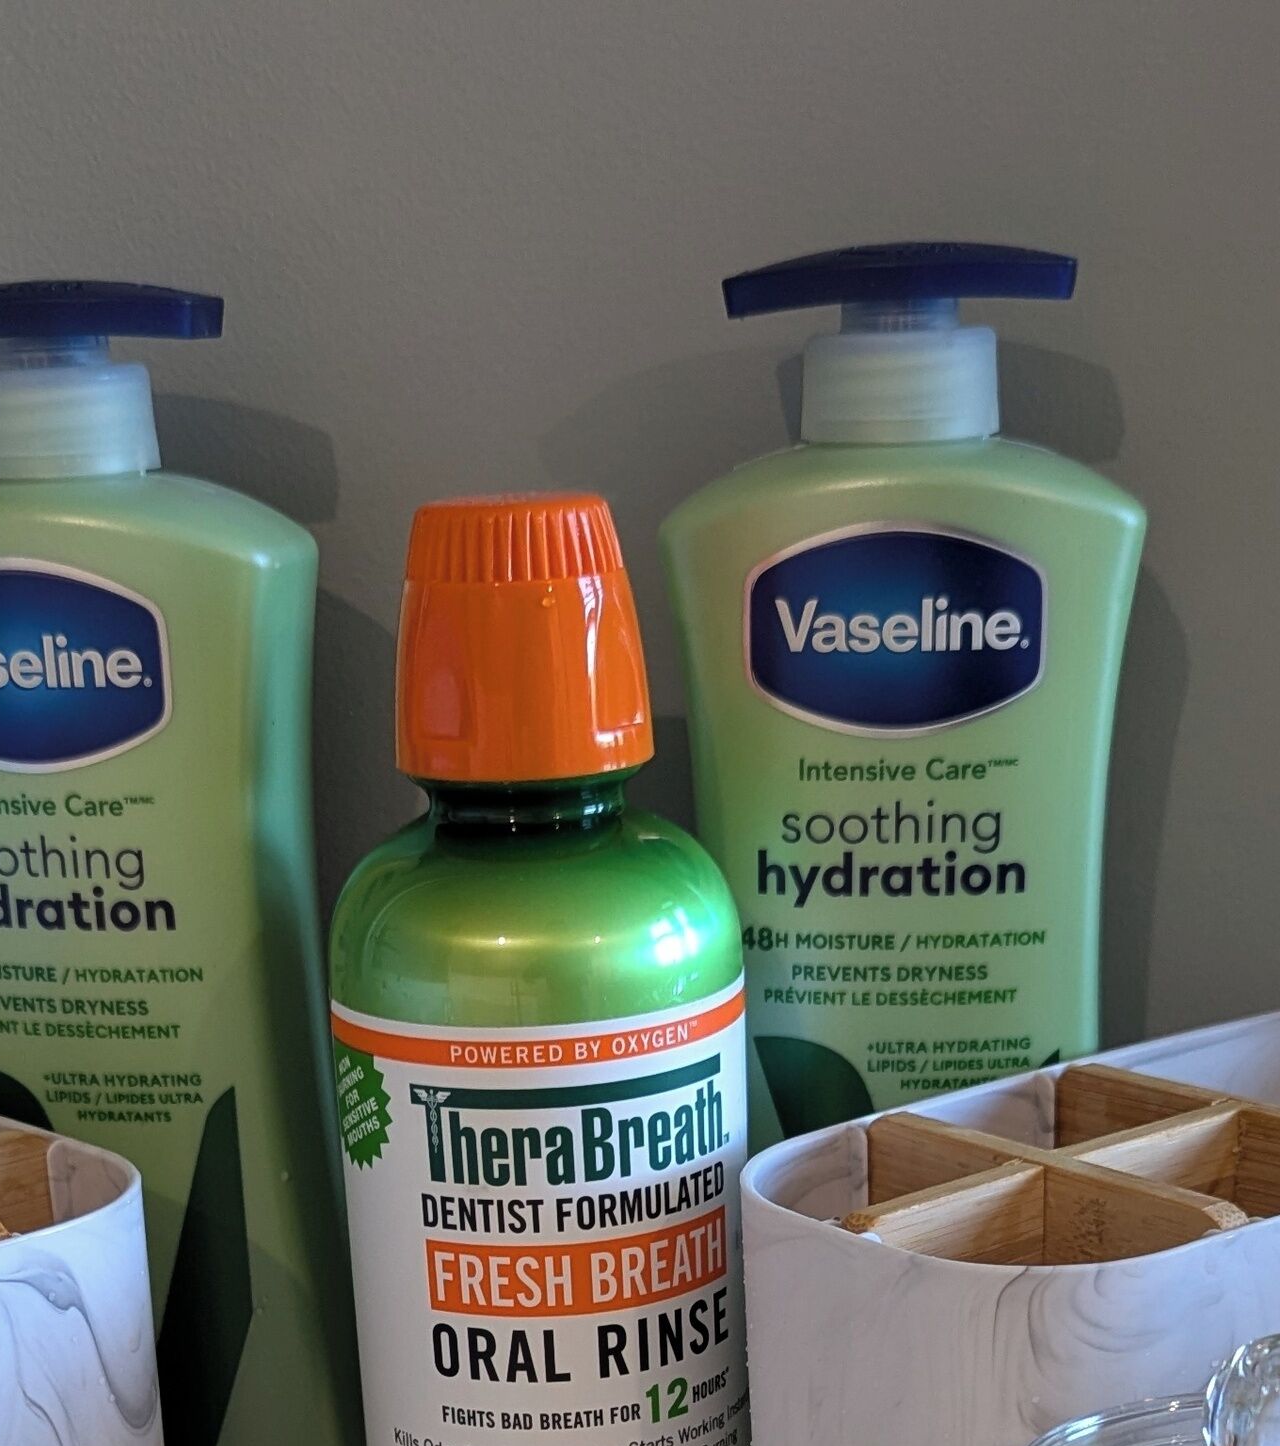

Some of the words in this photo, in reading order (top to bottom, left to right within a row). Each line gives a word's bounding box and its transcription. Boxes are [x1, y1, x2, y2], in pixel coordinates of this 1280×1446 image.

[799, 757, 916, 782] Intensive
[781, 799, 1001, 855] soothing
[757, 849, 1025, 908] hydration
[795, 933, 895, 951] MOISTURE
[916, 929, 1047, 950] HYDRATATION
[76, 967, 204, 985] HYDRATATION
[791, 964, 891, 983] PREVENTS
[897, 963, 989, 982] DRYNESS
[62, 999, 150, 1017] DRYNESS
[764, 986, 847, 1006] PRÉVIENT
[852, 991, 871, 1007] LE
[23, 1022, 41, 1036] LE
[450, 1044, 563, 1065] POWERED
[575, 1040, 601, 1062] BY
[932, 1037, 1031, 1054] HYDRATING
[867, 1059, 916, 1073] LIPIDS
[987, 1056, 1030, 1070] ULTRA
[104, 1073, 202, 1088] HYDRATING
[45, 1090, 91, 1105] LIPIDS
[346, 1115, 380, 1146] MOUTHS
[421, 1192, 544, 1234] DENTIST
[555, 1162, 725, 1234] FORMULATED
[433, 1250, 573, 1308] FRESH
[590, 1218, 723, 1304] BREATH
[432, 1322, 572, 1384] ORAL
[597, 1286, 729, 1379] RINSE
[441, 1405, 496, 1429] FIGHTS
[501, 1407, 533, 1431] BAD
[539, 1408, 604, 1431] BREATH
[610, 1403, 641, 1426] FOR
[645, 1377, 690, 1424] 12
[678, 1412, 725, 1446] Working
